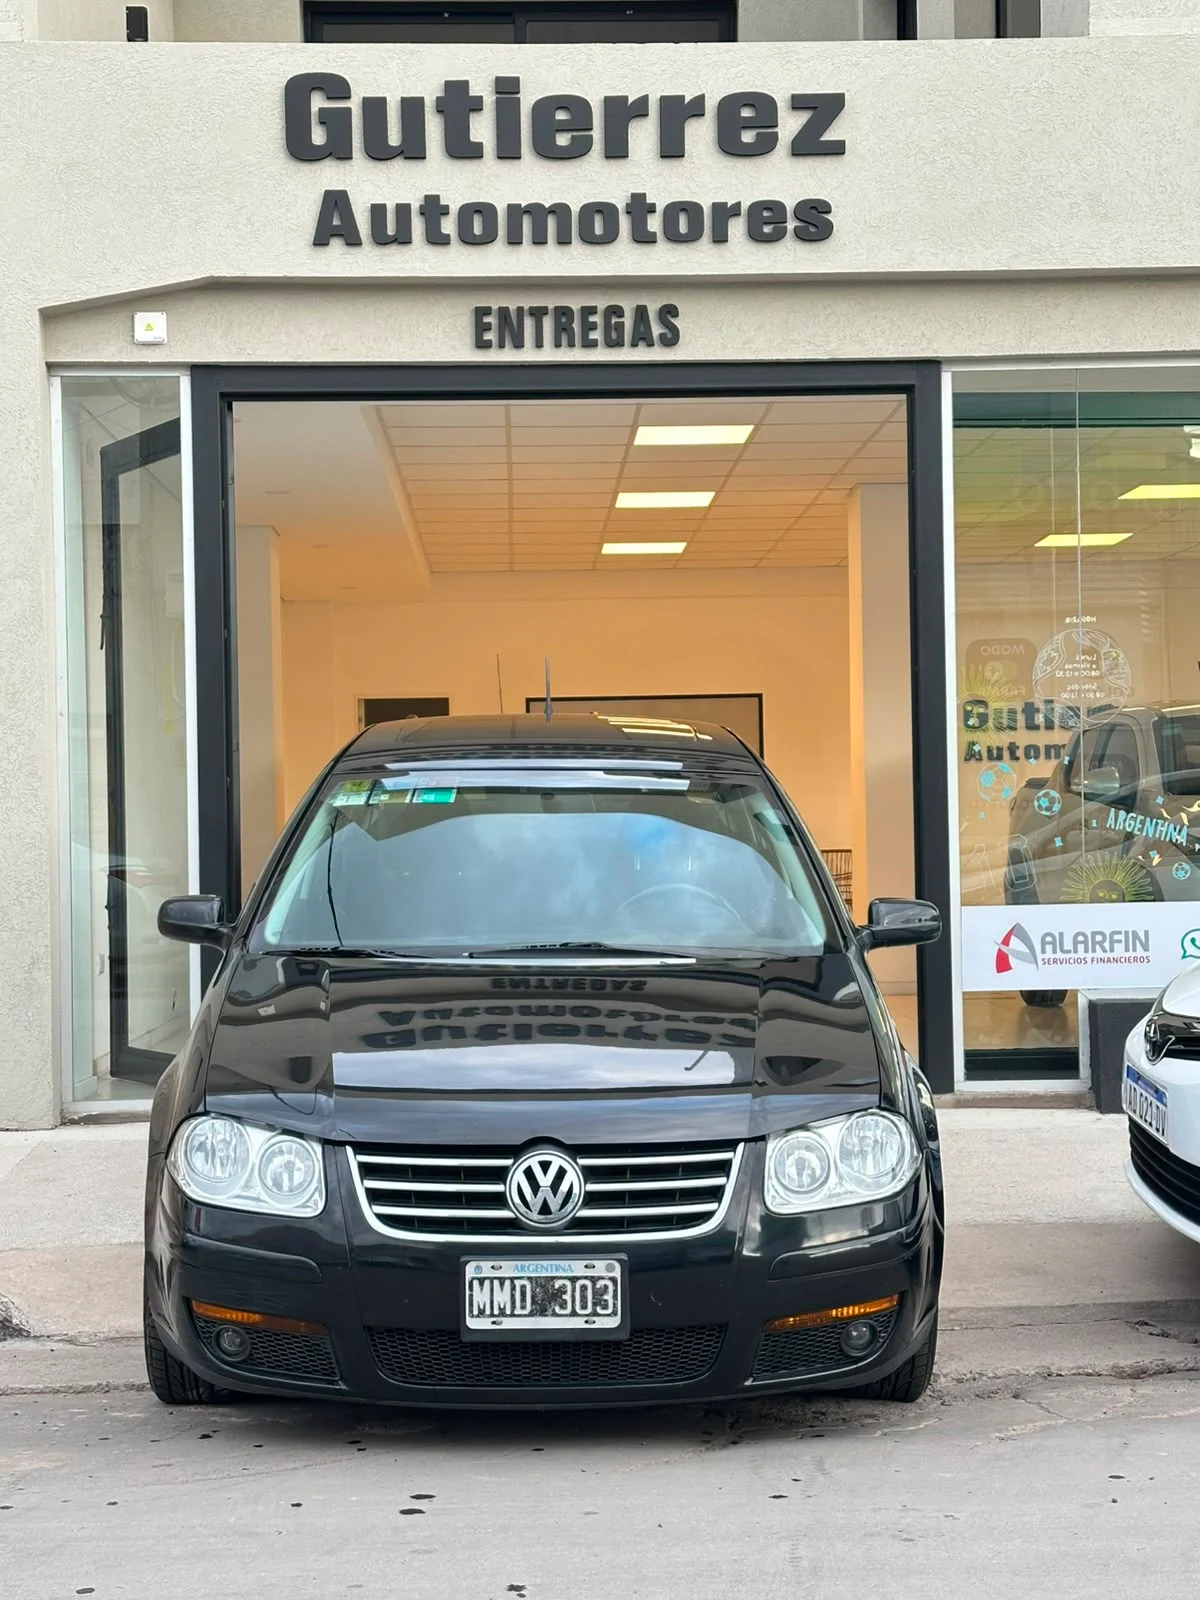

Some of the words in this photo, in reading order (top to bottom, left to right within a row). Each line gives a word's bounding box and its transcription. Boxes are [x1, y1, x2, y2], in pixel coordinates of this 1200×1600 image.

[284, 72, 846, 161] Gutierrez
[312, 189, 834, 246] Automotores
[474, 303, 680, 349] ENTREGAS
[1106, 807, 1188, 847] ARGENTINA
[1040, 930, 1150, 954] ALARFIN
[1041, 957, 1088, 966] SERVICIOS
[1090, 955, 1151, 965] FINANCIEROS
[512, 1263, 574, 1273] ARGENTINA
[472, 1279, 532, 1315] MMD
[554, 1279, 614, 1315] 303
